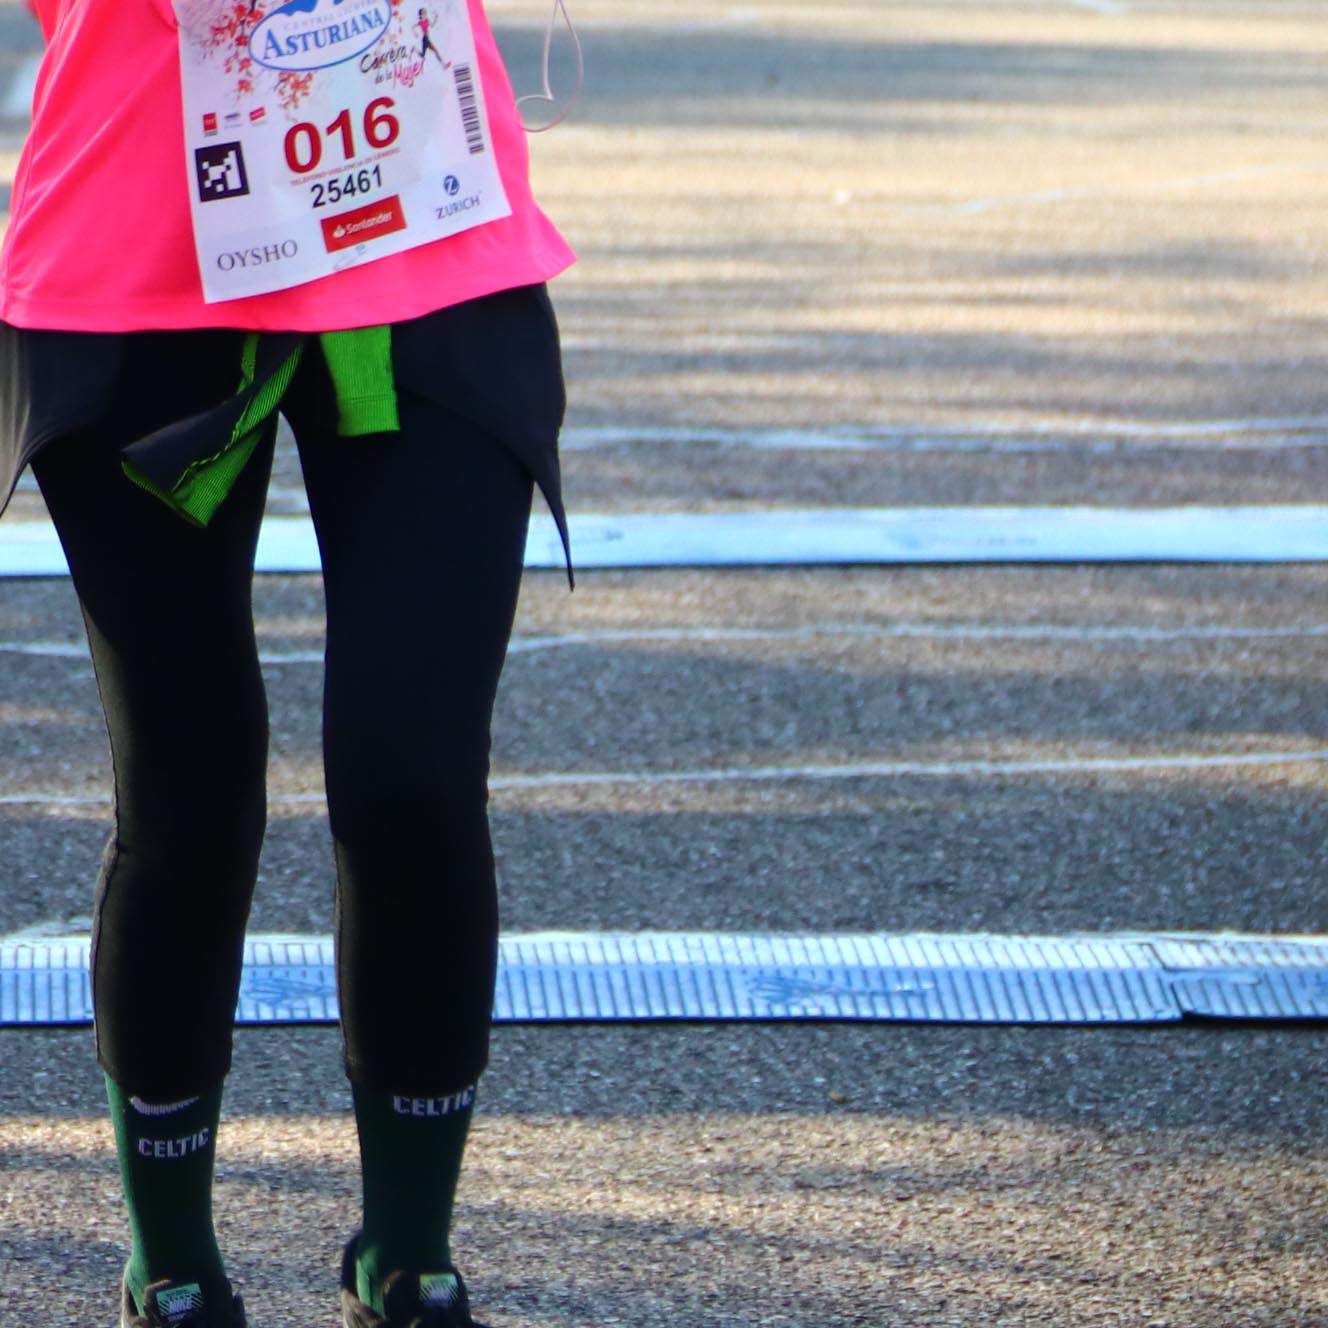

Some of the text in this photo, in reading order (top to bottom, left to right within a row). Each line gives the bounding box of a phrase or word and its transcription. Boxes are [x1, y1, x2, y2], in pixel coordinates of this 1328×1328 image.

[263, 8, 386, 60] ASTURIANA
[284, 96, 400, 174] 016
[310, 165, 382, 208] 25461
[346, 210, 393, 235] Santander
[435, 196, 480, 220] ZURICH
[217, 239, 298, 272] OYSHO
[392, 1084, 475, 1116] CELTIC
[138, 1127, 210, 1158] CELTIC
